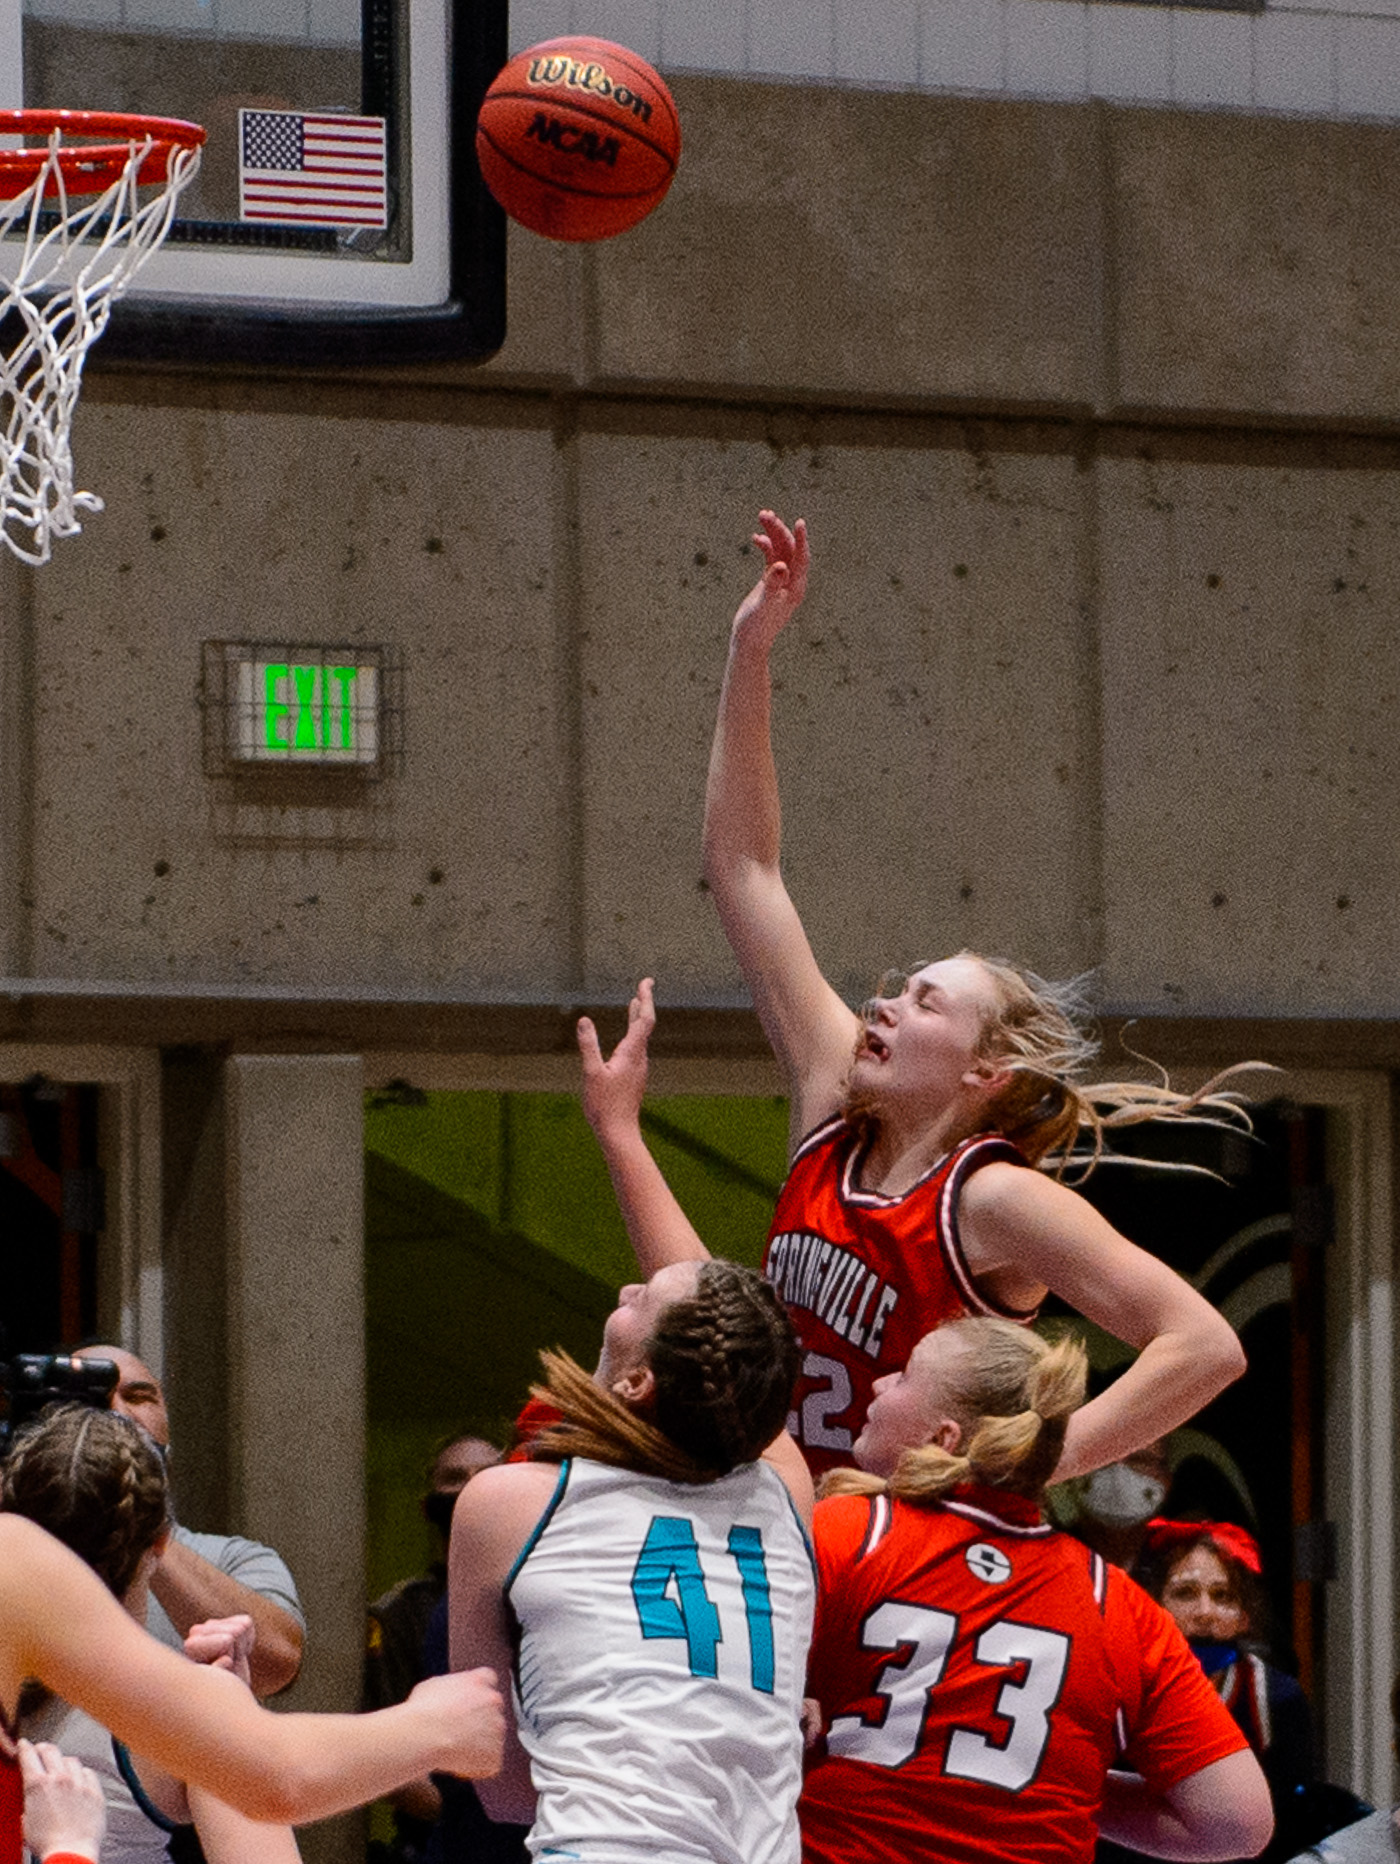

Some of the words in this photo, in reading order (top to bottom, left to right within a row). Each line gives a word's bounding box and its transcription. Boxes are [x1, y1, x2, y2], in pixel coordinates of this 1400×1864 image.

[523, 110, 622, 167] NCAA
[528, 55, 653, 124] Wilson
[265, 663, 357, 751] EXIT
[787, 1343, 853, 1453] 2
[629, 1513, 776, 1696] 41
[826, 1600, 1073, 1794] 33
